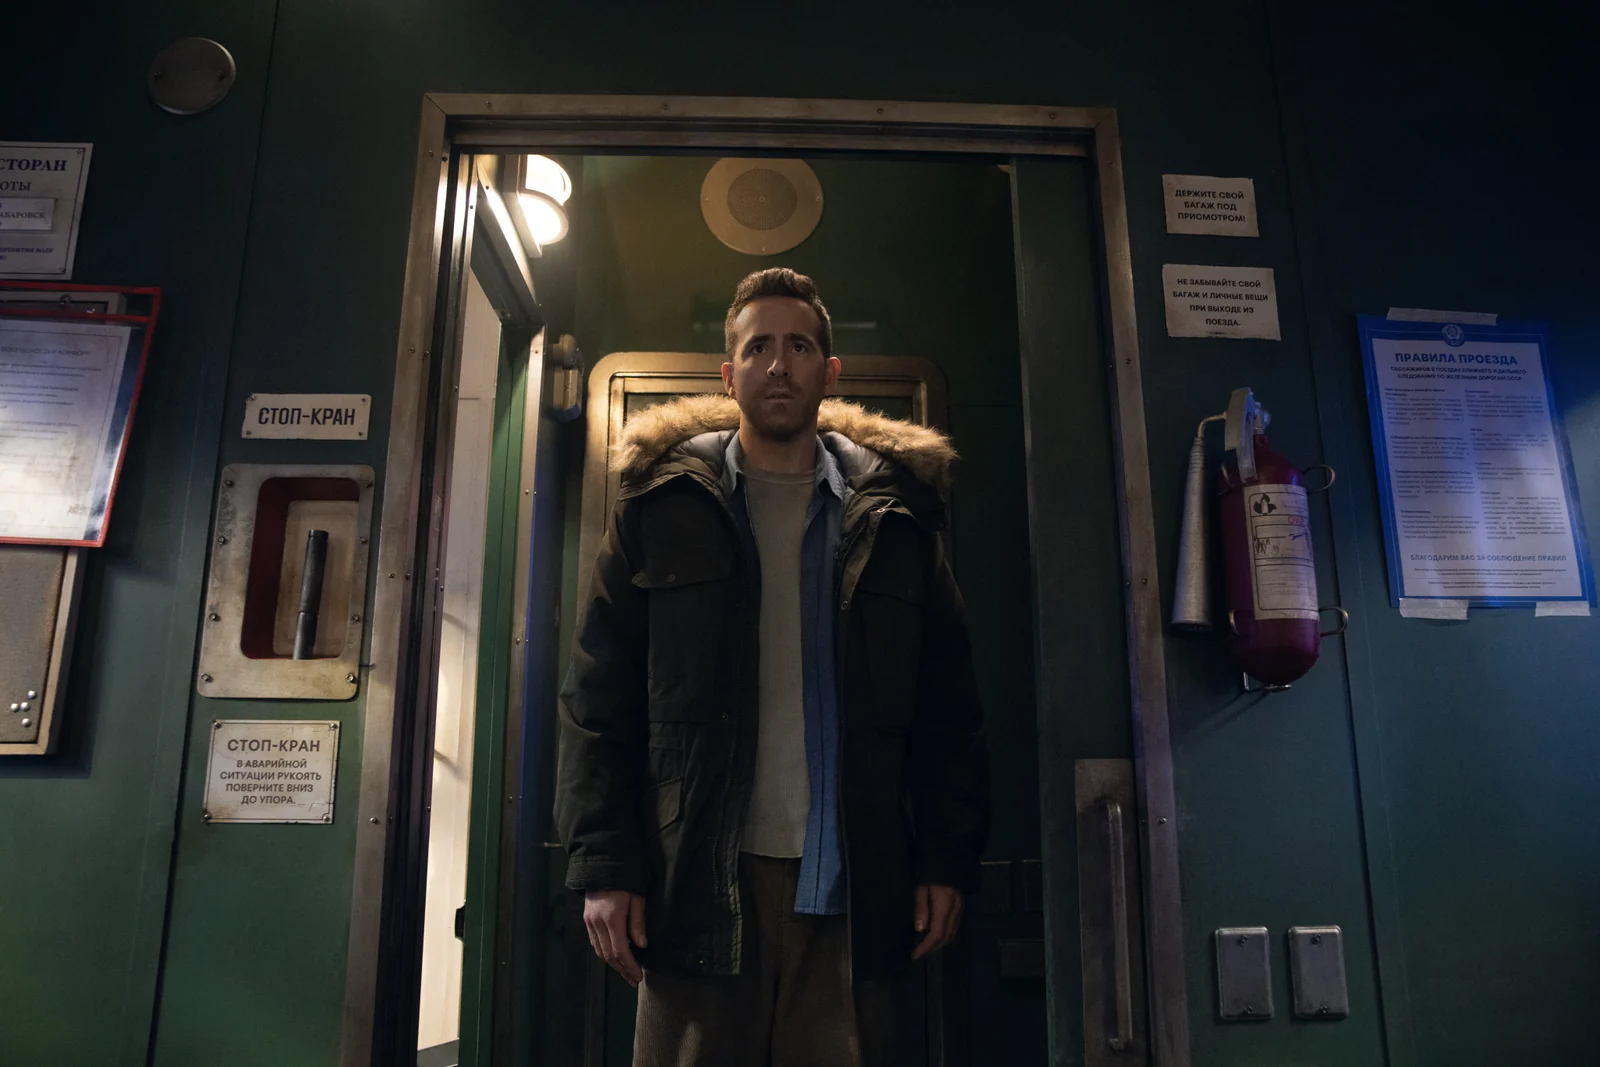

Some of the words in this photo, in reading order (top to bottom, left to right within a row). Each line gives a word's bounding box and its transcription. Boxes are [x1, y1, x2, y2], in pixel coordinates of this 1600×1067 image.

[1175, 190, 1216, 198] ДЕРЖИТЕ
[1219, 191, 1244, 199] СВОЙ
[1184, 201, 1215, 209] БАГАЖ
[1217, 203, 1237, 211] ПОД
[1177, 212, 1246, 222] ПРИСМОТРОМ!
[1189, 278, 1236, 287] ЗАБЫВАЙТЕ
[1238, 280, 1261, 288] СВОЙ
[1210, 292, 1243, 300] ЛИЧНЫЕ
[1208, 306, 1241, 314] ВЫХОДЕ
[1395, 353, 1456, 364] ПРАВИЛА
[1459, 354, 1518, 366] ПРОЕЗДА
[258, 407, 355, 425] СТОП-КРАН
[1410, 554, 1459, 562] БЛАГОДАРИМ
[227, 739, 320, 752] СТОП-КРАН
[237, 760, 243, 768] В
[246, 758, 307, 768] АВАРИЙНОЙ
[220, 772, 275, 781] СИТУАЦИИ
[277, 772, 321, 780] РУКОЯТЬ
[225, 783, 284, 792] ПОВЕРНИТЕ
[287, 784, 313, 792] ВНИЗ
[241, 796, 257, 805] ДО
[260, 796, 296, 804] УПОРА.
